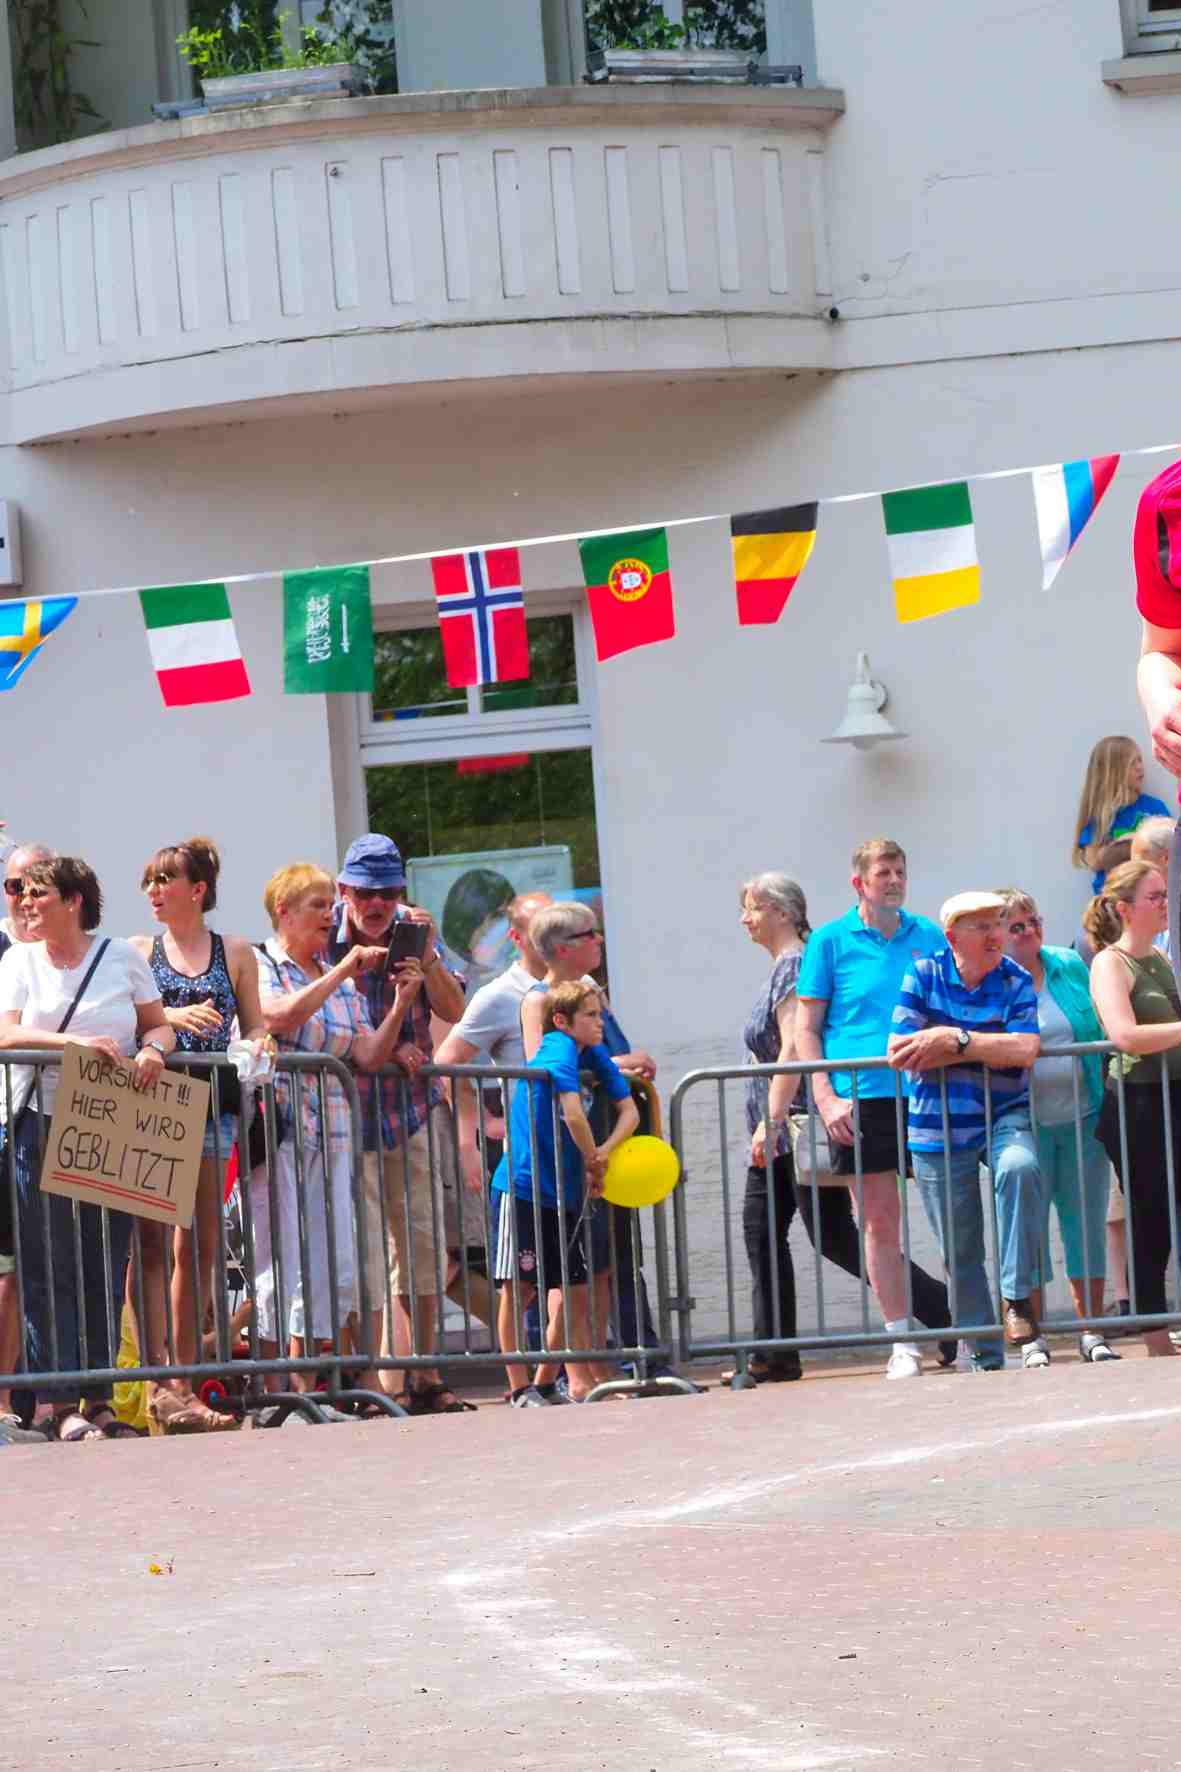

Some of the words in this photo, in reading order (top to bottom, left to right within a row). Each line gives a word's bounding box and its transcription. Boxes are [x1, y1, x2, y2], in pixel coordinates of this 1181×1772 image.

[70, 1090, 118, 1125] HIER
[136, 1108, 185, 1141] WIRD
[57, 1125, 184, 1198] GEBLITZT
